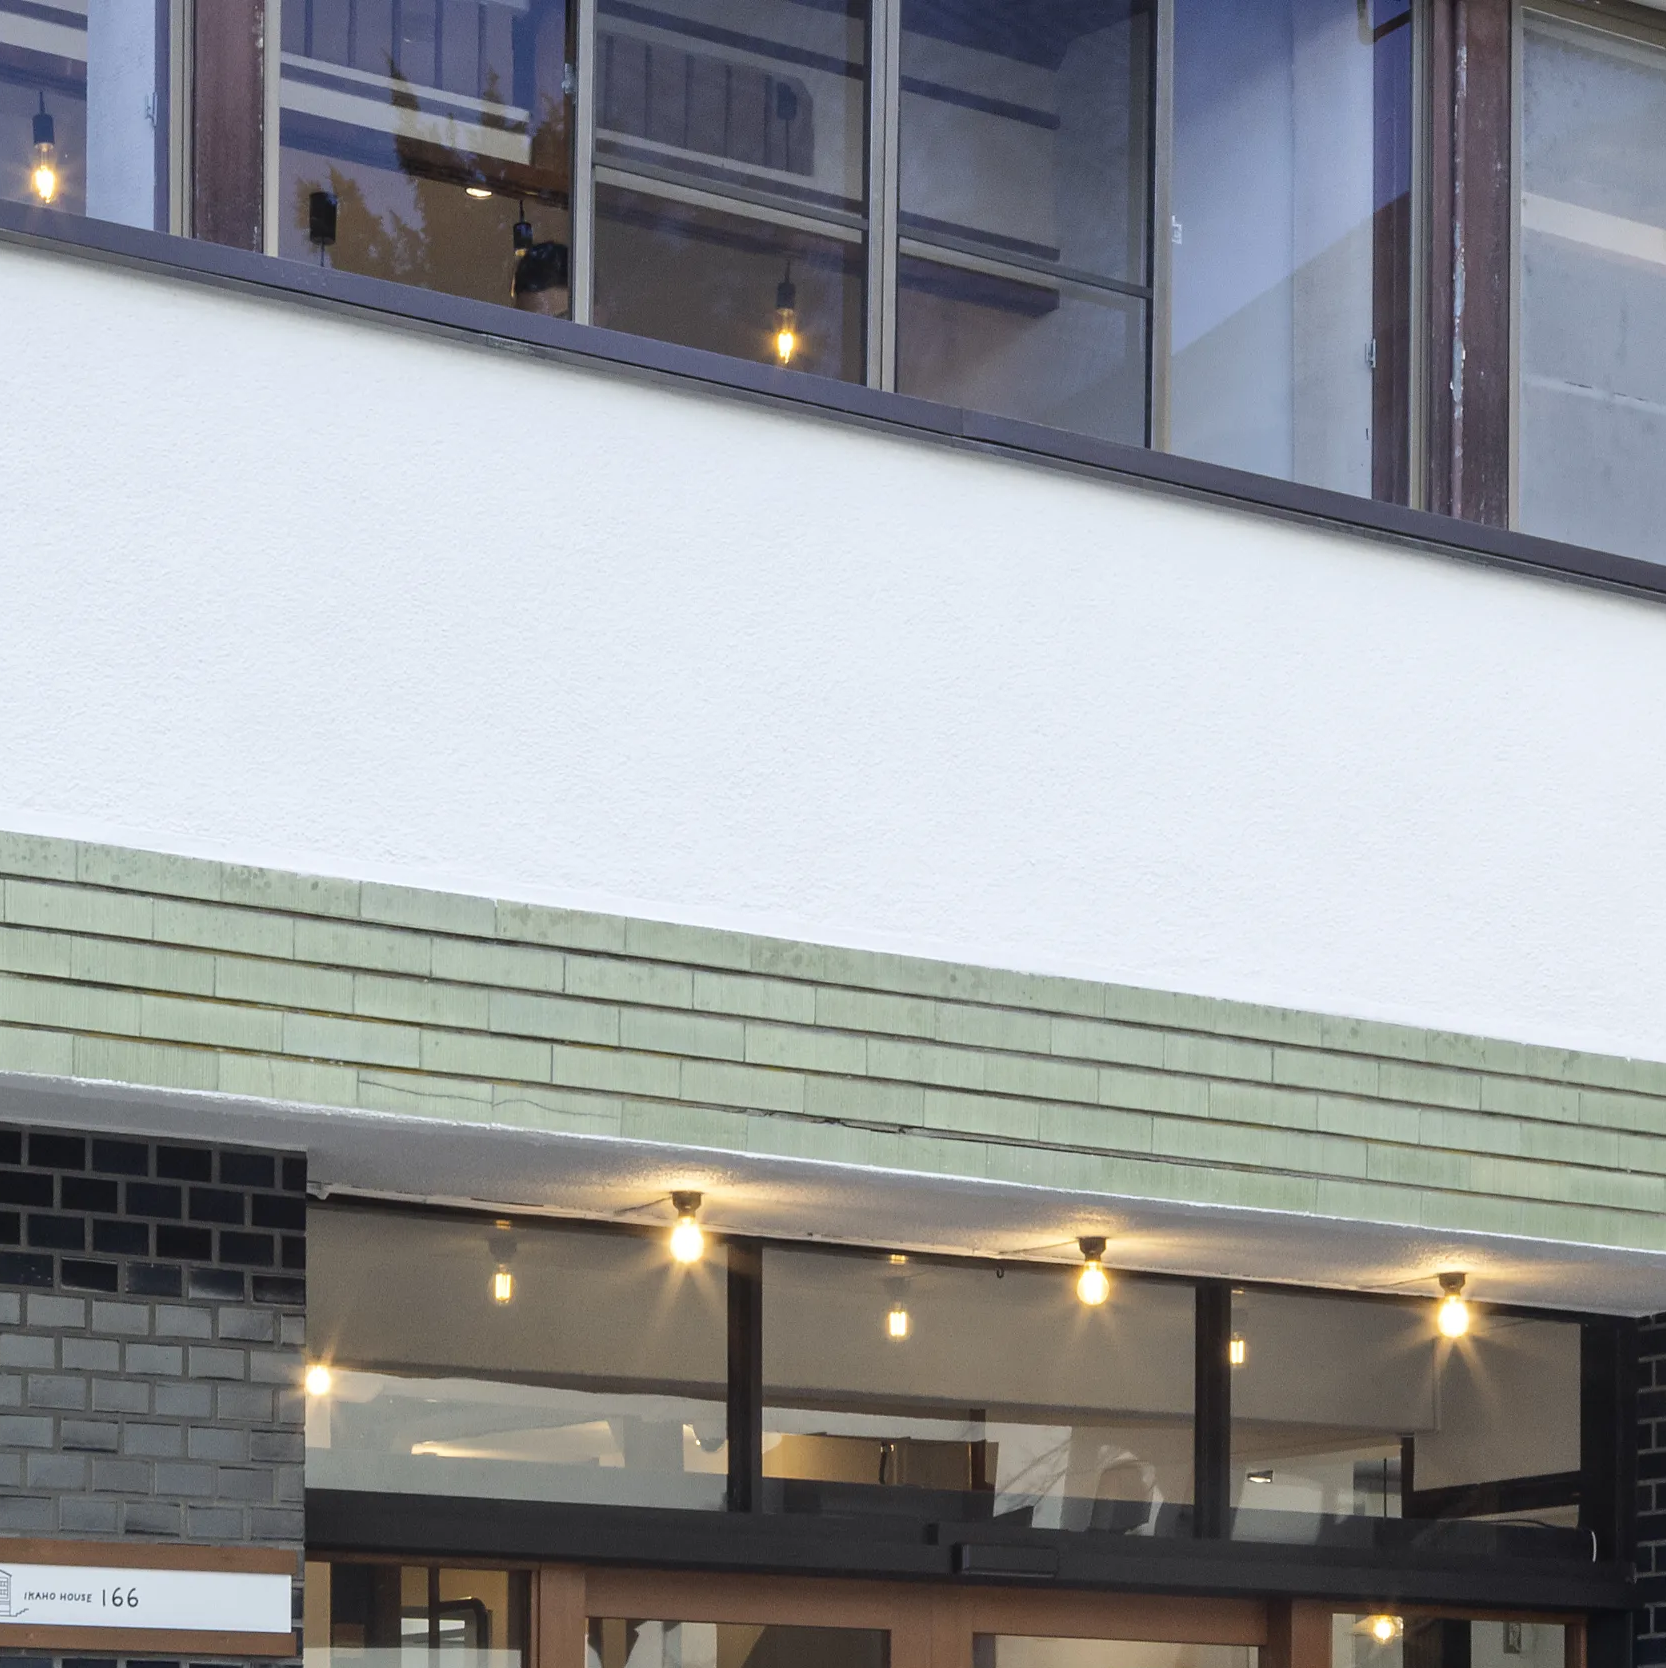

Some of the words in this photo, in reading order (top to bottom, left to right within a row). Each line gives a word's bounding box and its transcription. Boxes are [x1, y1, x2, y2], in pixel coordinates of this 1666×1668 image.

[23, 1591, 57, 1601] IKAHO
[59, 1592, 93, 1604] HOUSE
[103, 1587, 138, 1607] 166
